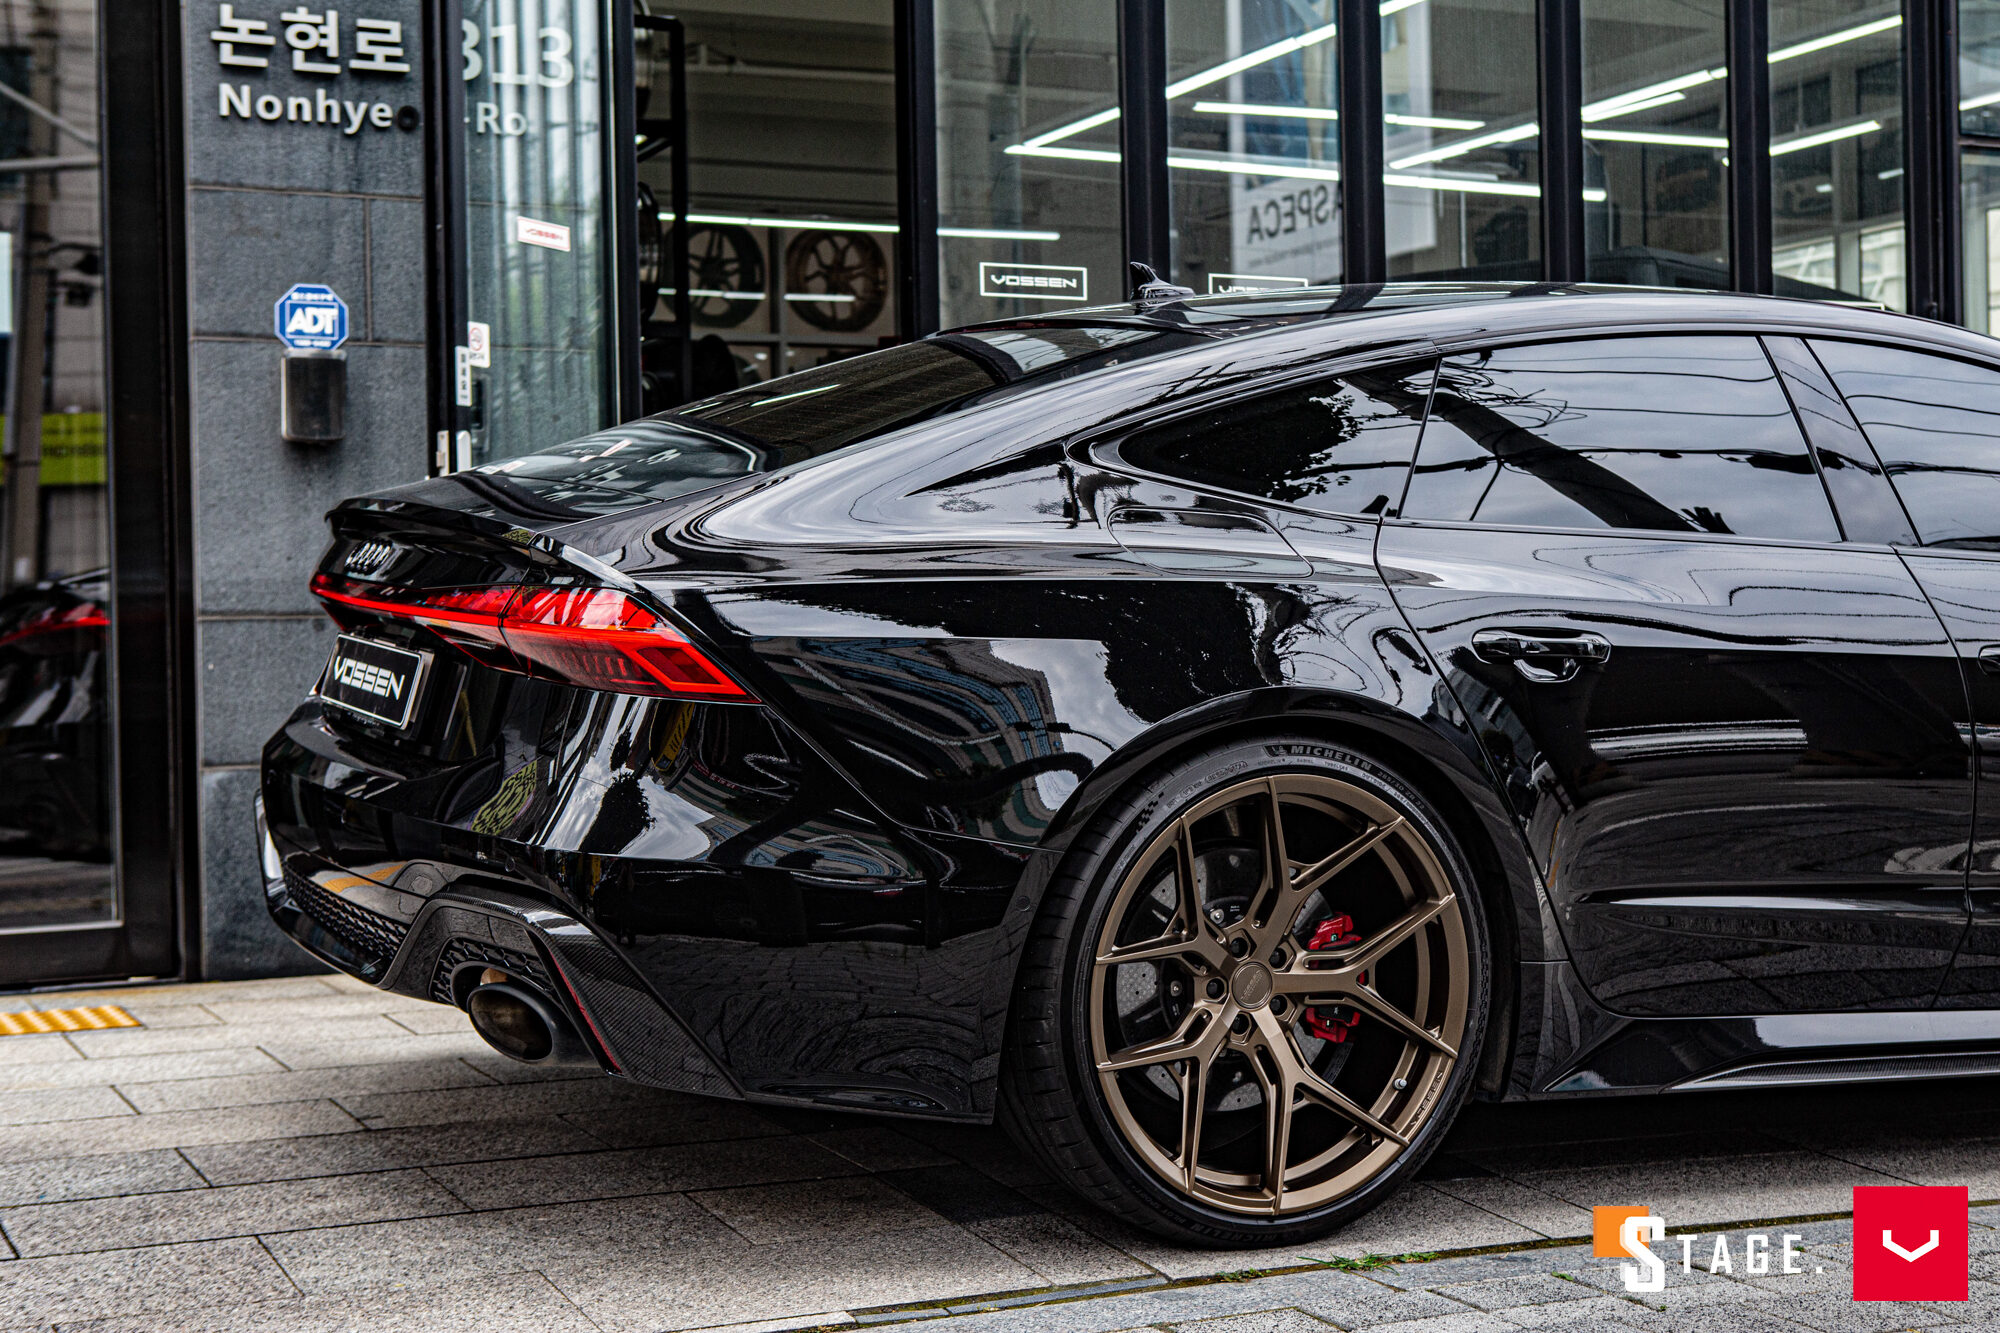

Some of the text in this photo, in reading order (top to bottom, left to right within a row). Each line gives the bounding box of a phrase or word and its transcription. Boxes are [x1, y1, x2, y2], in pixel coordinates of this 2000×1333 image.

[210, 3, 410, 74] 논현로
[989, 273, 1078, 289] VOSSEN
[286, 306, 339, 335] ADT
[333, 655, 406, 701] VOSSEN
[1290, 745, 1372, 771] MICHELIN
[1410, 1072, 1443, 1126] VOSSEN
